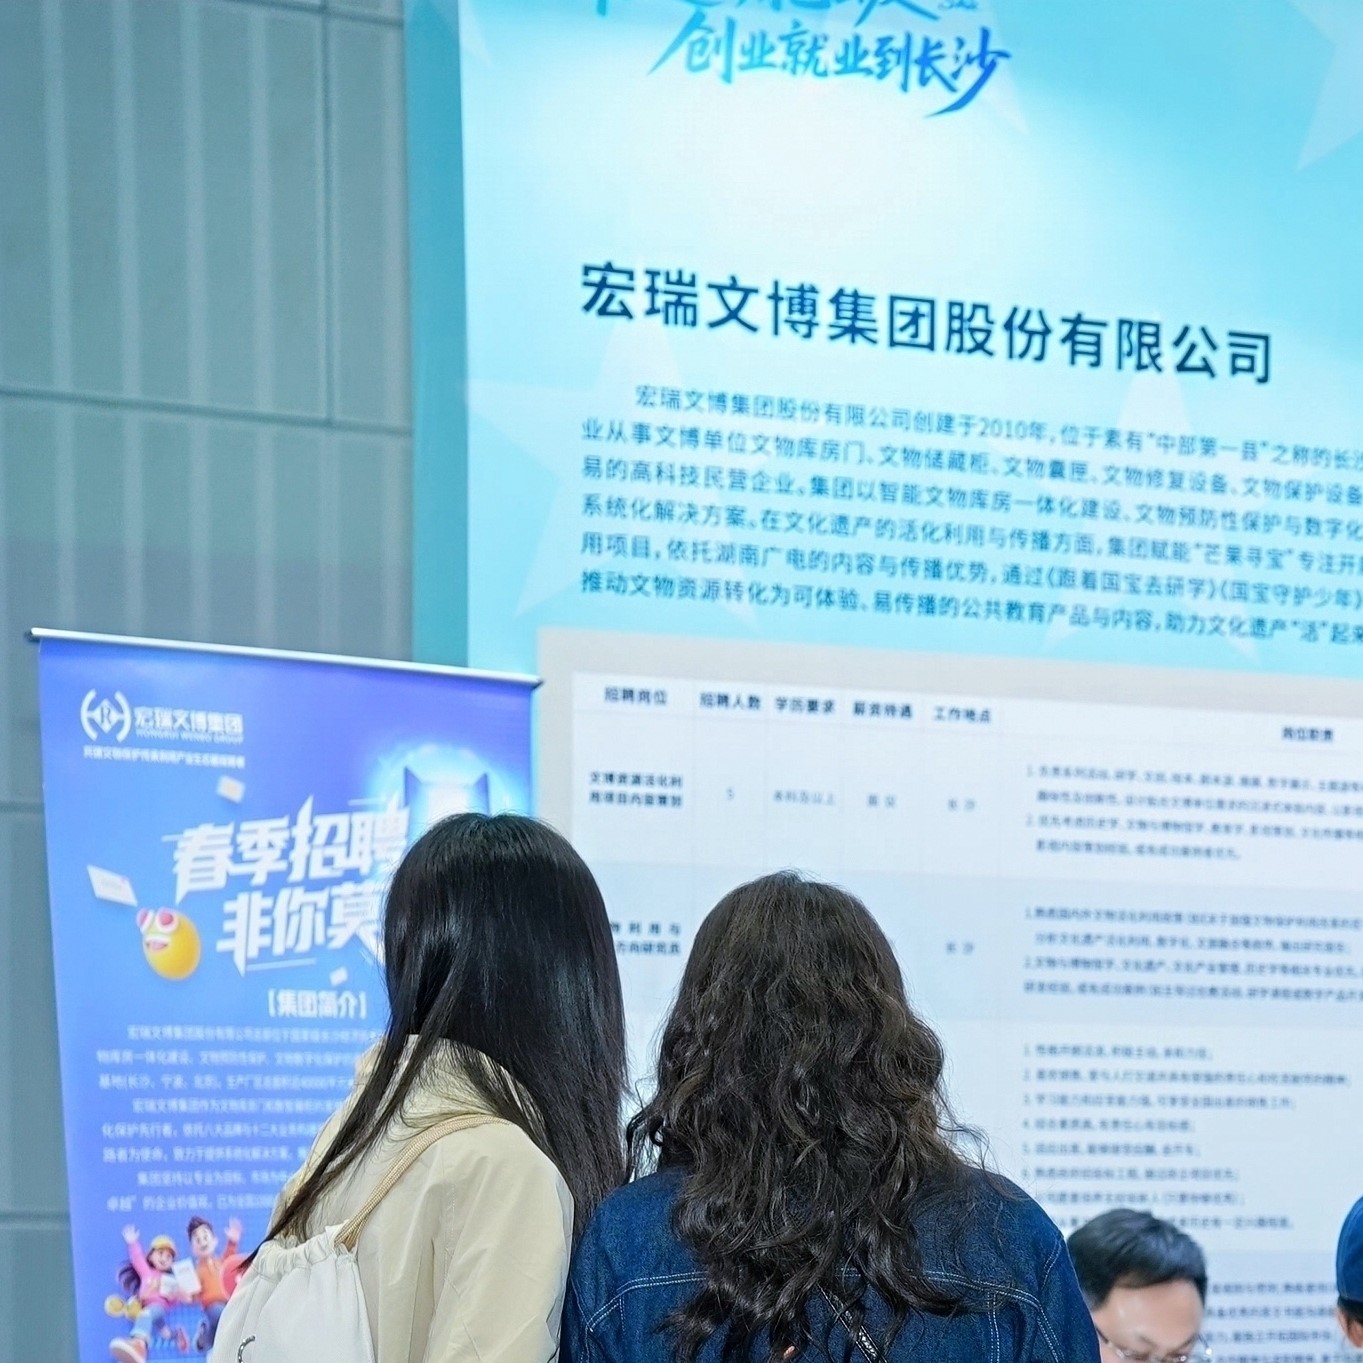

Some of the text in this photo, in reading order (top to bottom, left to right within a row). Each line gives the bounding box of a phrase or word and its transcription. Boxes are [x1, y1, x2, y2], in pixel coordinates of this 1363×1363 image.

[647, 4, 1011, 118] 创业就业到长沙
[581, 262, 1272, 384] 宏瑞文博集团股份有限公司
